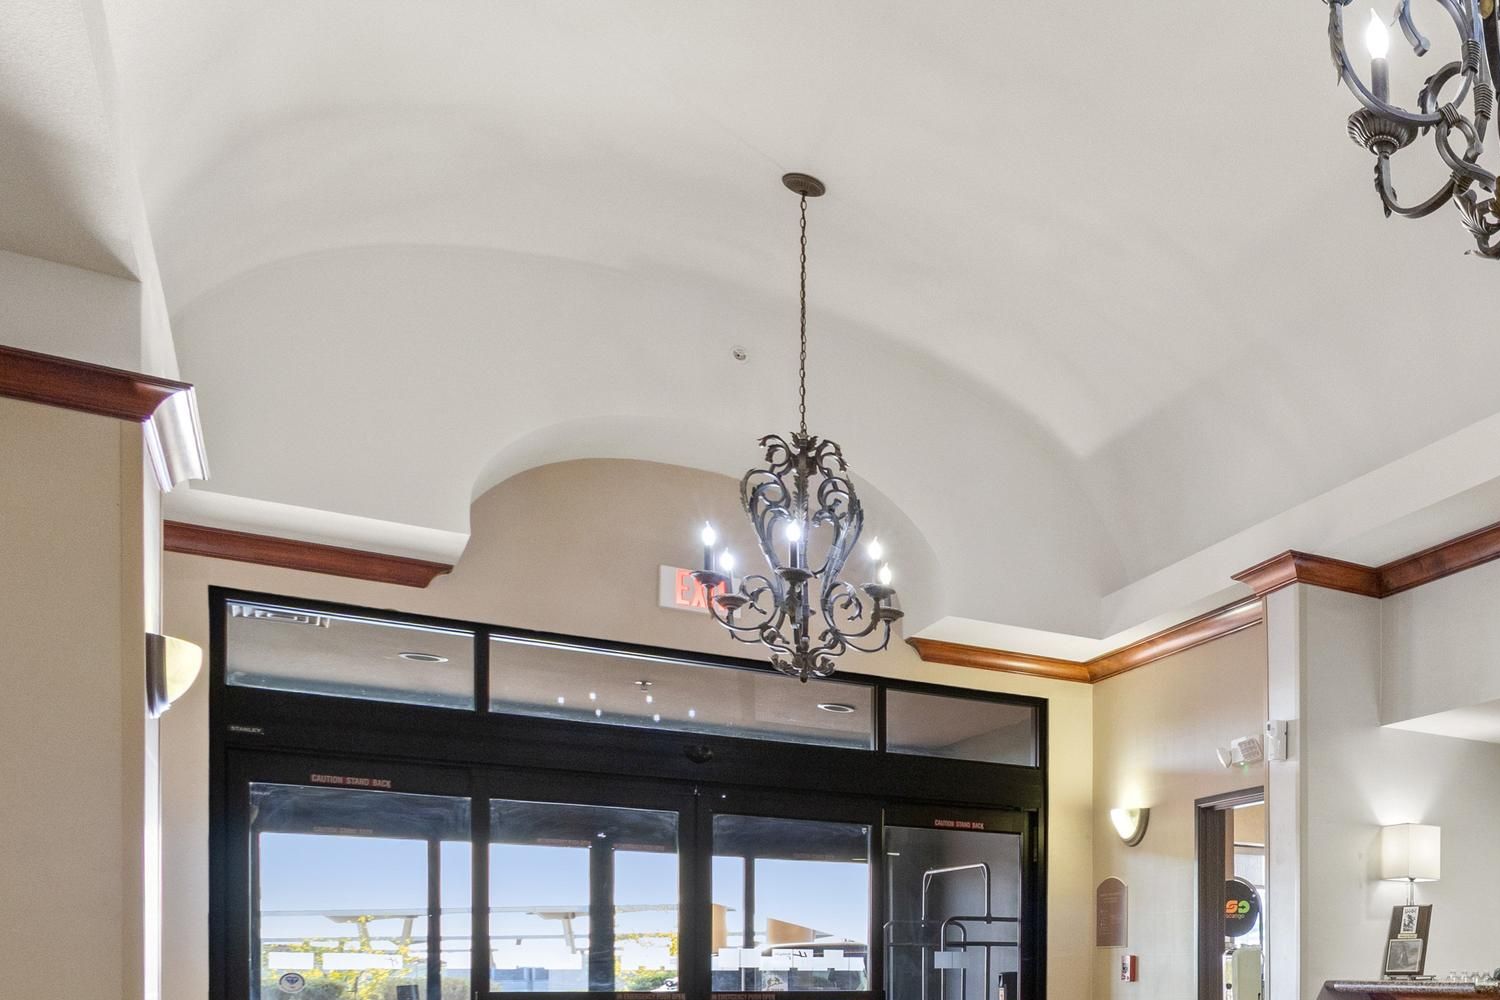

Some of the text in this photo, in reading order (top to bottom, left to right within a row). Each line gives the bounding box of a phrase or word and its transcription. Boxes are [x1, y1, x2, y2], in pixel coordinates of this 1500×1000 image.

[311, 774, 392, 788] CAUTION STAND BACK
[934, 819, 985, 830] CAUTION STAND BACK
